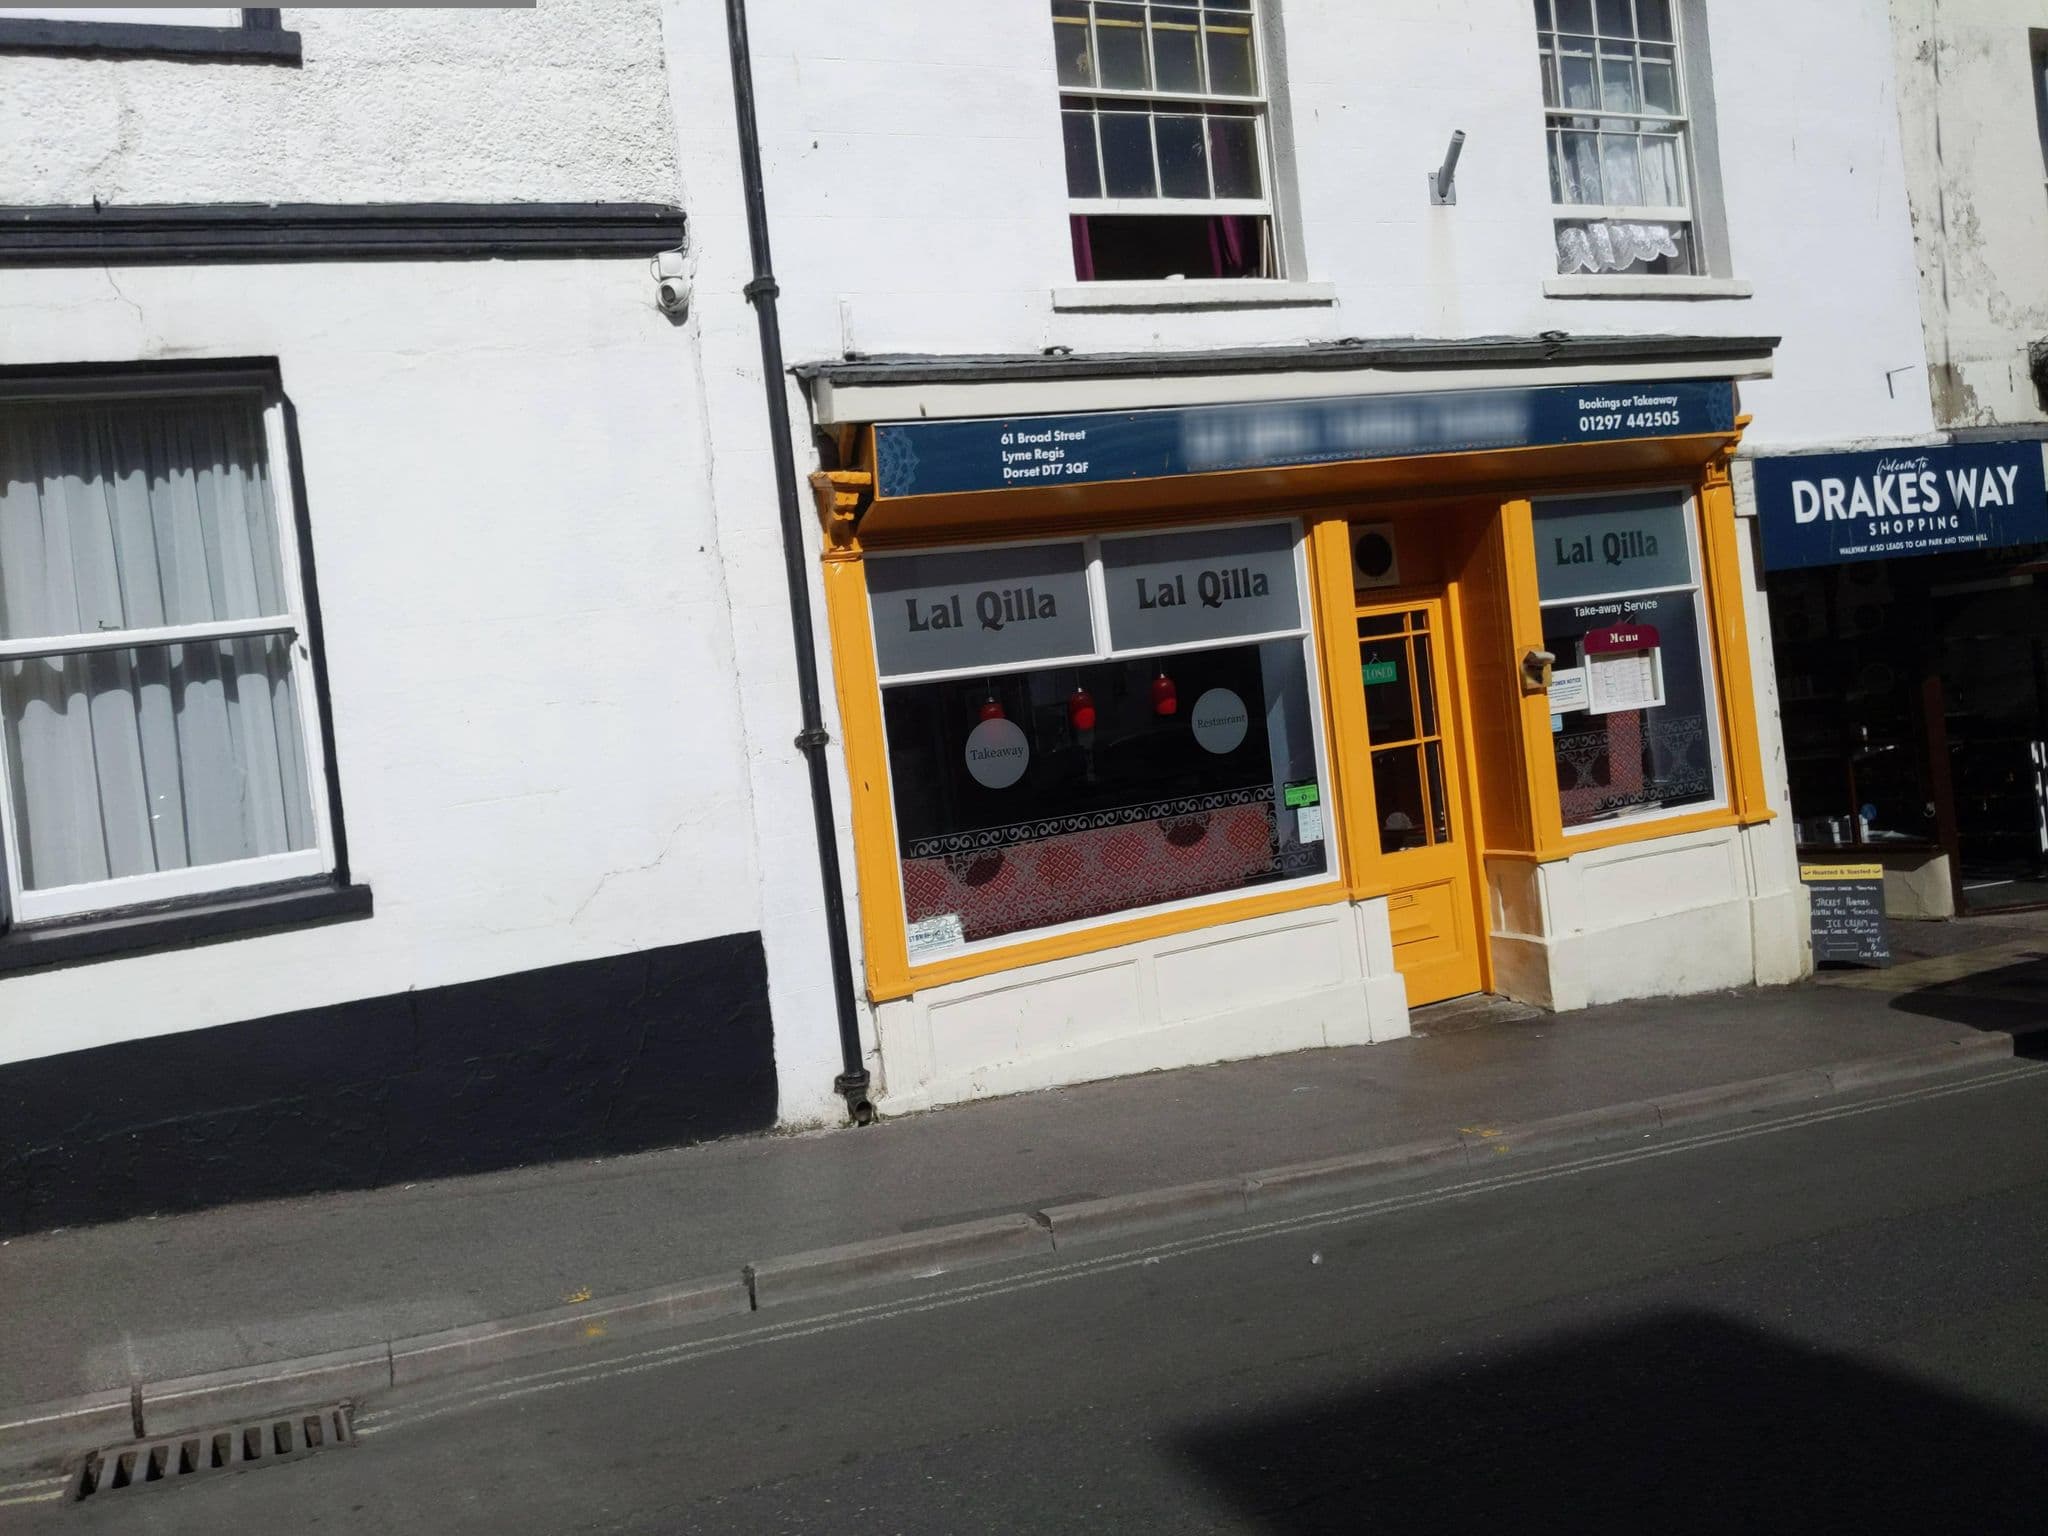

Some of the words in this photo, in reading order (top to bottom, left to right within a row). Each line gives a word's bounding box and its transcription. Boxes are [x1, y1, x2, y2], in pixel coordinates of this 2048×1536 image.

[1578, 398, 1621, 411] Bookings
[1622, 398, 1632, 407] or
[1632, 395, 1678, 407] Takeaway
[1579, 414, 1622, 431] 01297
[1626, 411, 1680, 428] 442505
[1000, 432, 1014, 445] 61
[1017, 430, 1051, 444] Broad
[1054, 429, 1086, 442] Street
[1002, 449, 1031, 463] Lyme
[1034, 446, 1065, 461] Regis
[1003, 464, 1039, 479] Dorset
[1042, 463, 1063, 476] DT7
[1065, 462, 1089, 475] 3QF
[1876, 456, 1916, 475] Welcome
[1792, 472, 1940, 524] DRAKES
[1947, 465, 2019, 510] WAY
[1869, 515, 1959, 536] SHOPPING
[1555, 535, 1594, 566] Lal
[1602, 531, 1659, 567] Qilla
[1839, 546, 1867, 555] WALKWAY
[1869, 544, 1885, 552] ALSO
[1886, 543, 1904, 551] LEADS
[1915, 540, 1927, 548] CAR
[1928, 538, 1943, 546] PARK
[1944, 536, 1956, 544] AND
[1958, 534, 1974, 544] TOWN
[1137, 574, 1186, 609] Lal
[1198, 567, 1270, 608] Qilla
[907, 595, 964, 632] Lal
[976, 587, 1057, 632] Qilla
[1574, 604, 1622, 618] Take-away
[1624, 599, 1658, 612] Service
[1609, 633, 1639, 644] Menu
[1362, 667, 1393, 681] LOSED
[1196, 712, 1247, 729] Restaurant
[969, 743, 1025, 762] Takeaway
